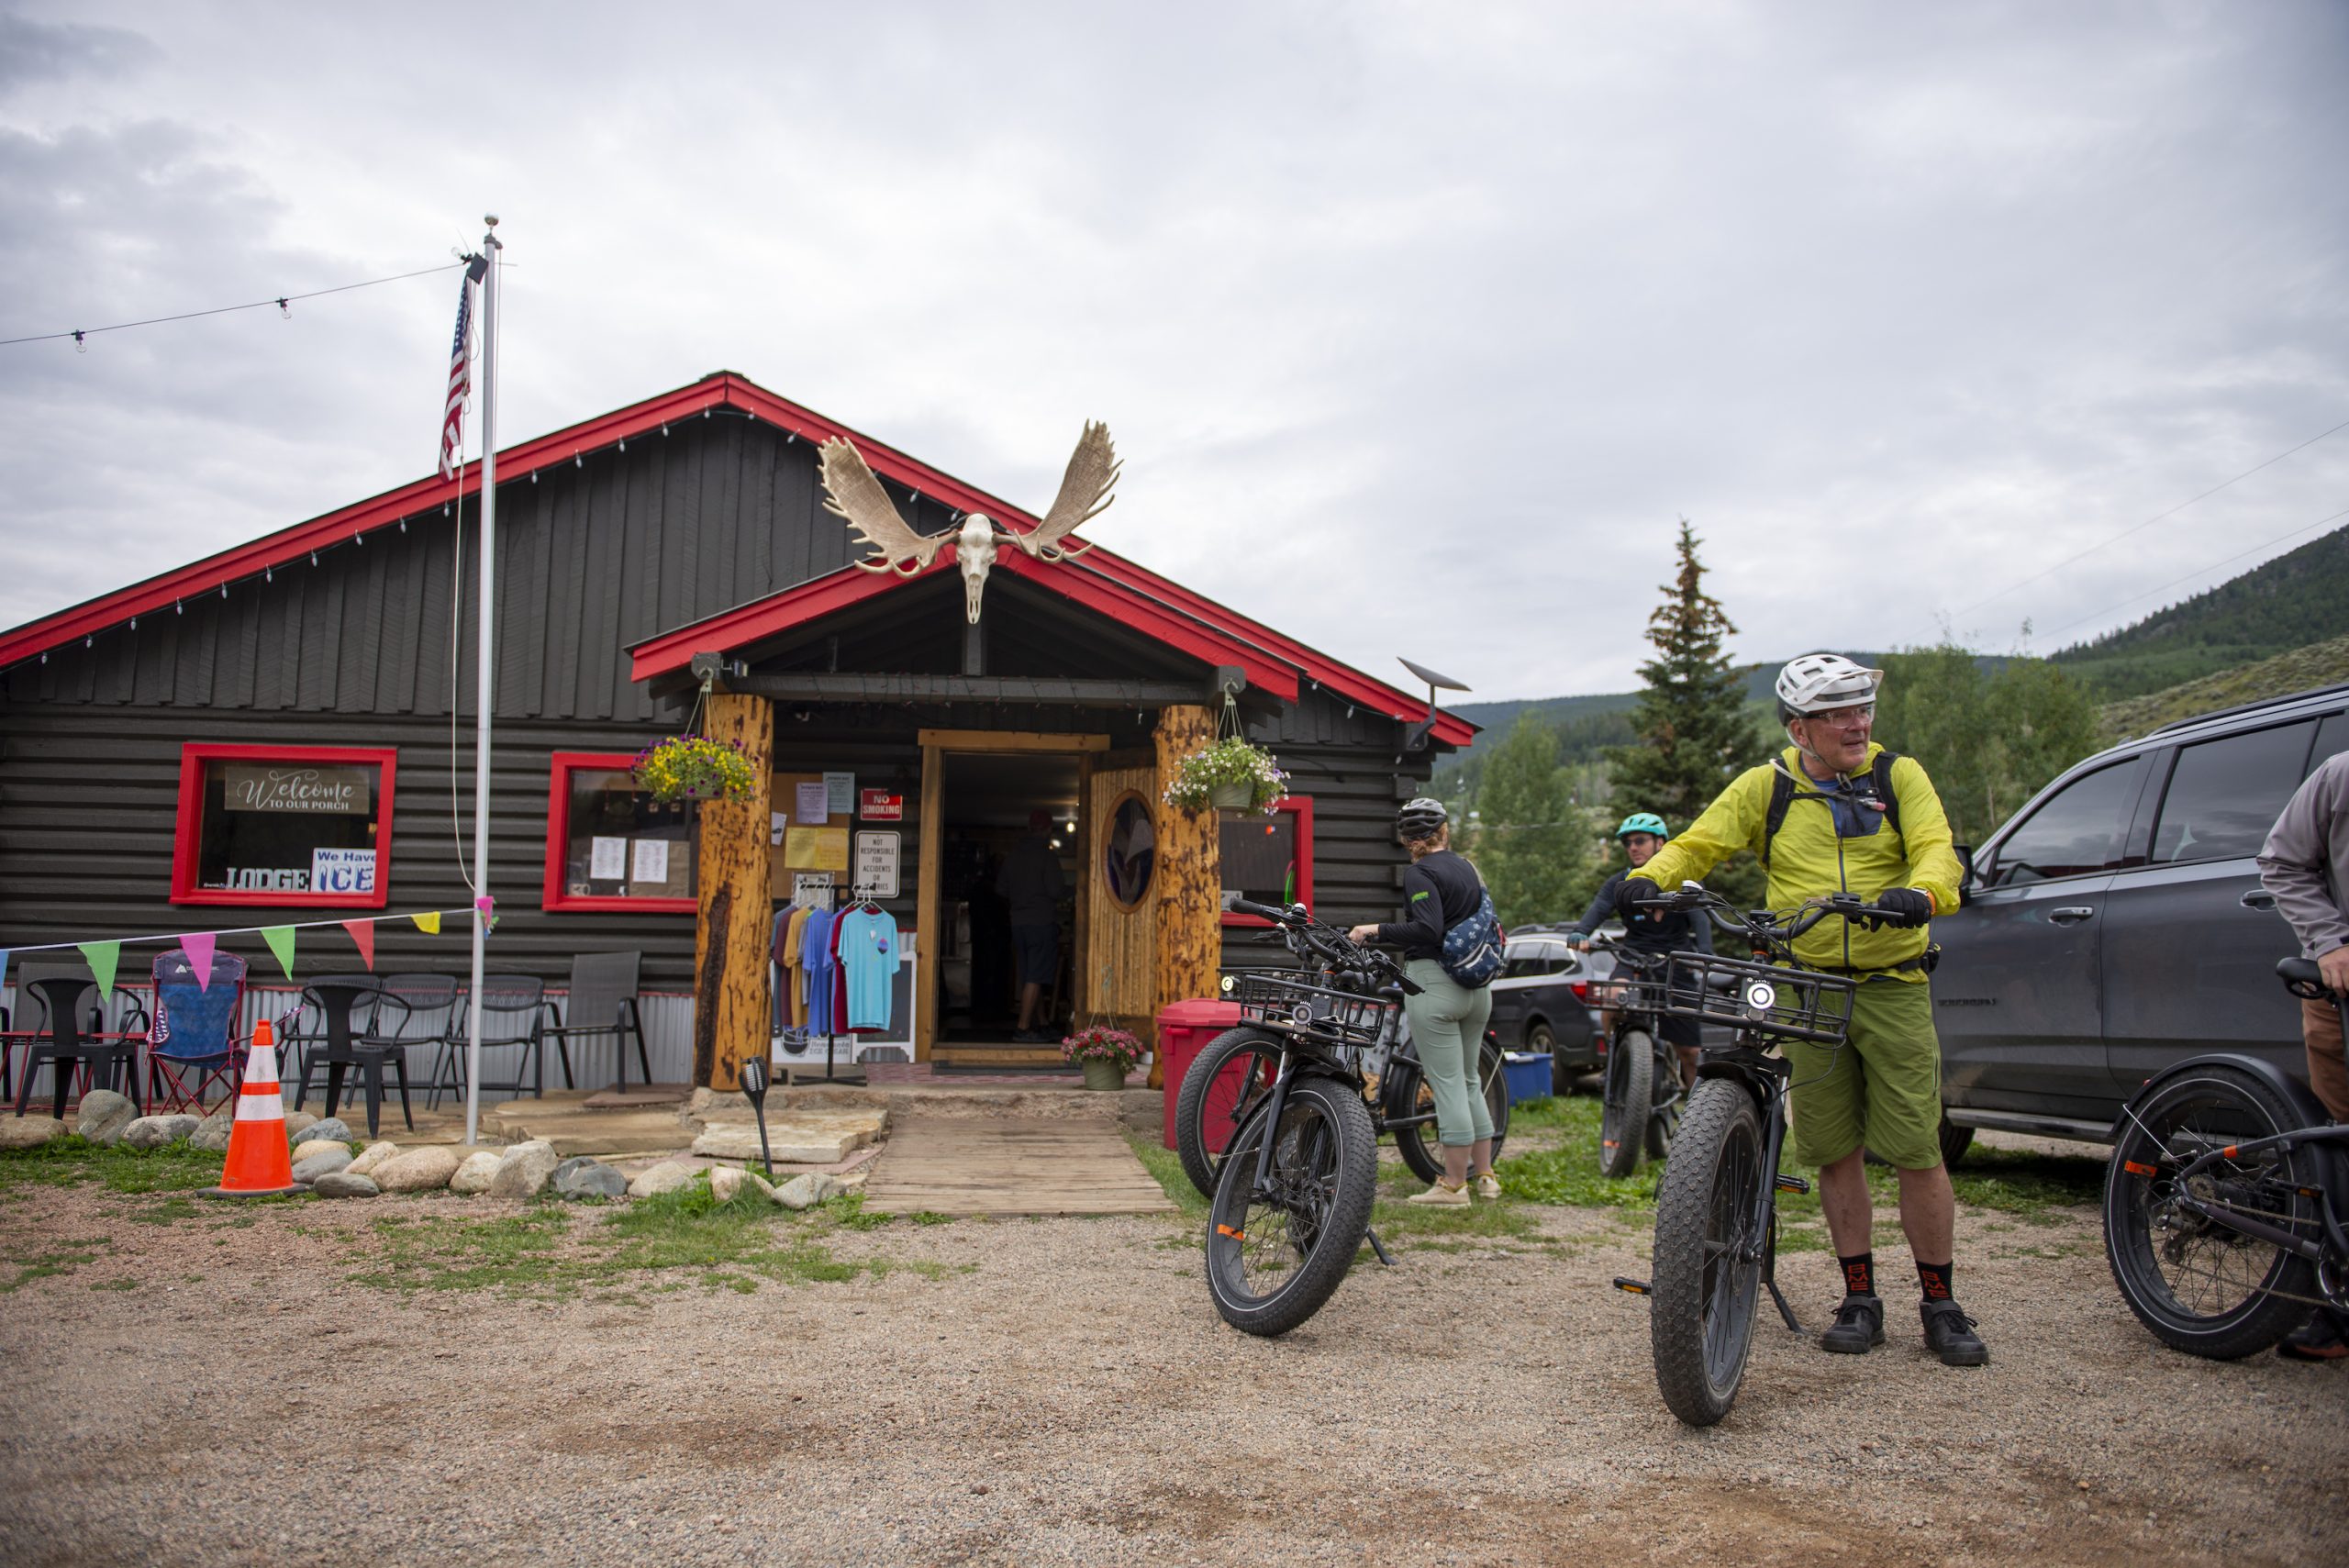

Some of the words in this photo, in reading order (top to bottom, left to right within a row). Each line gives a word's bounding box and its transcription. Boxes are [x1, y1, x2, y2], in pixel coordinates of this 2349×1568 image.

[237, 770, 355, 809] Welcome
[270, 800, 284, 808] TO
[286, 801, 308, 809] OUR
[312, 801, 349, 810] PORCH
[874, 795, 890, 805] NO
[863, 805, 900, 815] SMOKING
[860, 847, 896, 855] RESPONSIBLE
[317, 851, 340, 862] We
[863, 865, 891, 873] ACCIDENTS
[227, 867, 310, 892] LODGE
[318, 863, 374, 893] ICE
